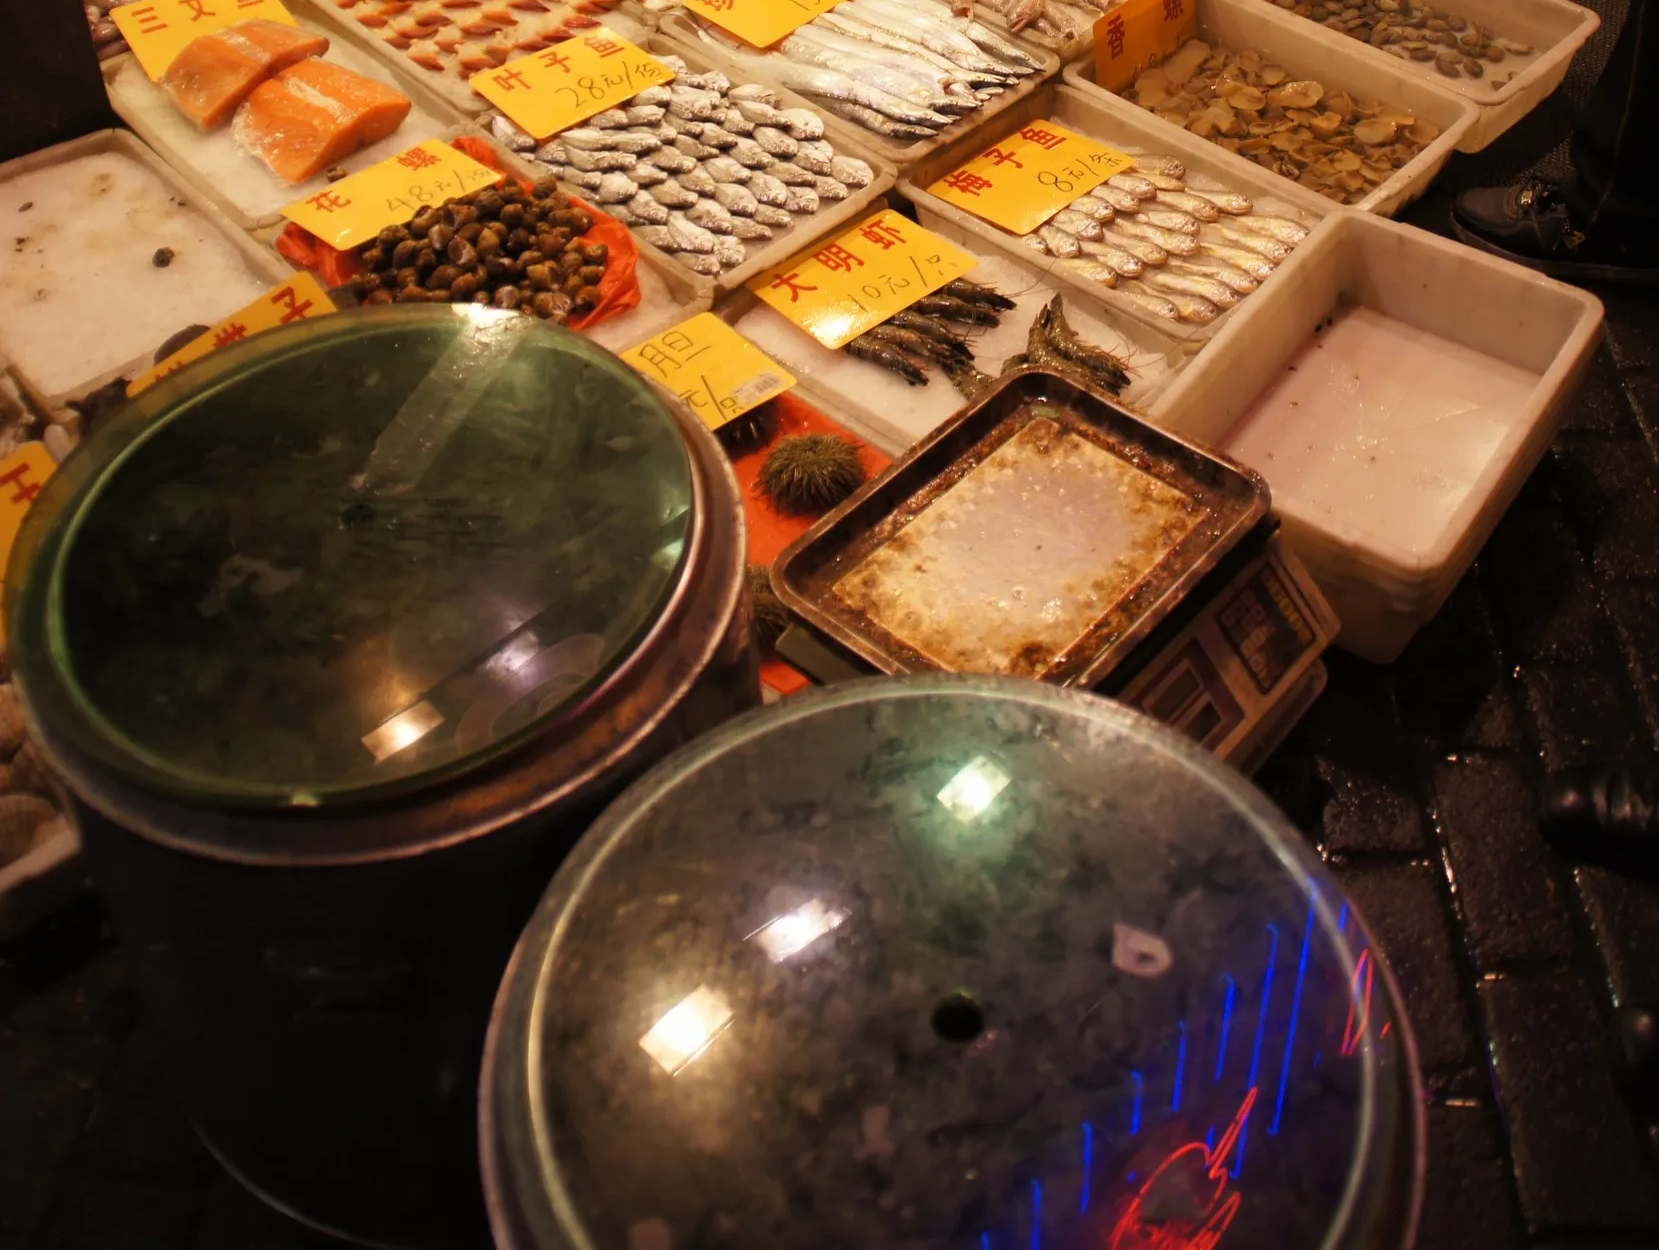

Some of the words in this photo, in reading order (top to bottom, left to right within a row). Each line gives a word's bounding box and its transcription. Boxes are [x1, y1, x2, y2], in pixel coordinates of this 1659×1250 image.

[492, 35, 625, 92] 叶子鱼
[306, 146, 442, 214] 花螺
[944, 128, 1068, 197] 梅子鱼
[1037, 152, 1123, 193] 8元/条
[770, 219, 907, 303] 大明虾
[847, 255, 958, 314] 10元/只
